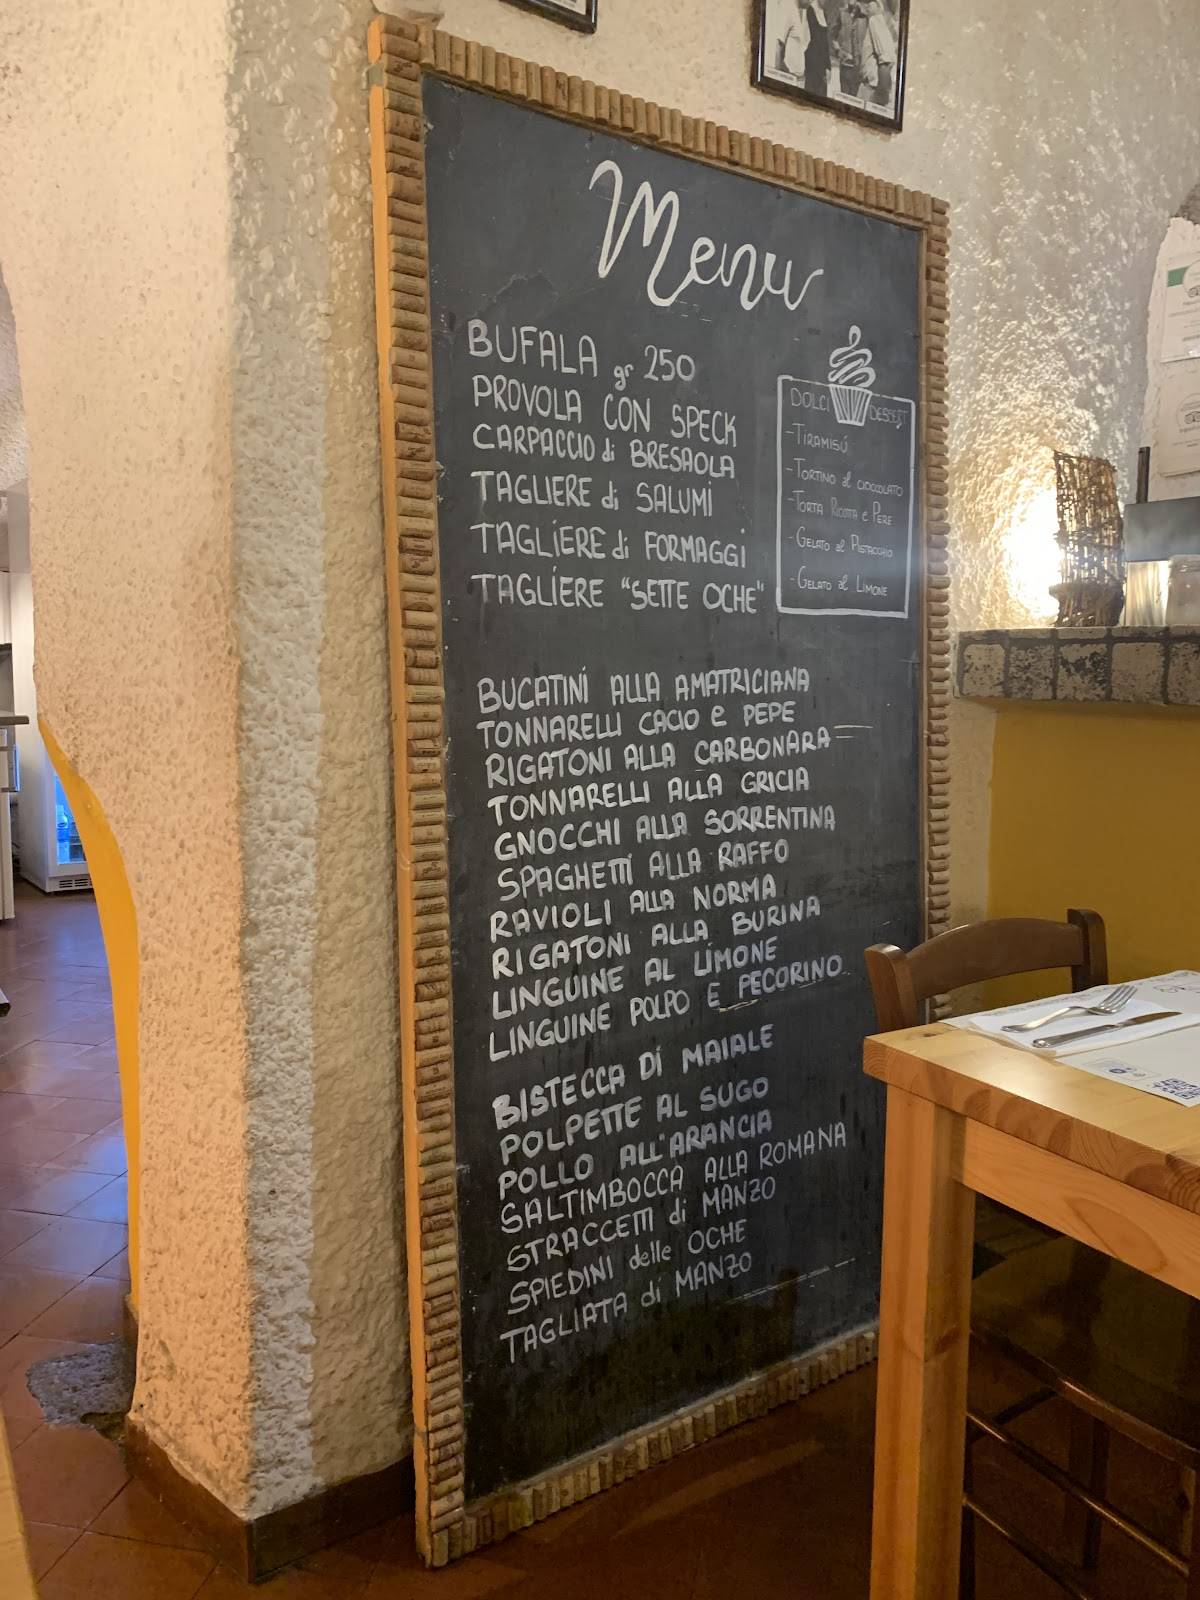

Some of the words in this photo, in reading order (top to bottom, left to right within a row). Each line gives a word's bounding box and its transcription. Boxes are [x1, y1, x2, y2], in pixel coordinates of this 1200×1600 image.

[589, 160, 824, 310] Menu
[468, 319, 598, 377] BUFALA
[613, 364, 634, 391] gr
[644, 345, 696, 381] 250
[472, 374, 582, 424] PROVOLA
[603, 394, 650, 433] CON
[671, 404, 737, 447] SPECK
[791, 388, 830, 412] DOLCI
[473, 423, 596, 462] CARPACCIO
[602, 438, 615, 462] di
[630, 439, 735, 478] BRESAOLA
[471, 471, 592, 507] TAGLIERE
[602, 481, 618, 510] di
[636, 481, 712, 516] SALUMI
[872, 501, 892, 525] PERE
[470, 520, 605, 559] TAGLIERE
[611, 529, 629, 560] di
[645, 528, 746, 568] FORMAGGI
[471, 565, 604, 608] TAGLIERE
[856, 575, 888, 596] LIMONE
[477, 666, 589, 713] BUCATINI
[610, 672, 660, 706] ALLA
[675, 666, 810, 701] AMATRICIANA
[476, 712, 622, 749] TONNARELLI
[639, 708, 700, 735] CACIO
[744, 701, 797, 727] PEPE
[485, 747, 612, 788] RIGATONI
[624, 743, 676, 771] ALLA
[695, 727, 832, 765] CARBONARA
[487, 780, 650, 826] TONNARELLI
[668, 773, 722, 803] ALLA
[741, 767, 809, 794] GRICIA
[494, 818, 620, 861] GNOCCHI
[636, 812, 687, 843] ALLA
[704, 805, 836, 836] SORRENTINA
[497, 853, 634, 901] SPAGHETTI
[650, 848, 702, 880] ALLA
[718, 838, 790, 871] RAFFO
[490, 899, 611, 943] RAVIOLI
[630, 889, 675, 914] ALLA
[694, 873, 777, 911] NORMA
[492, 932, 631, 980] RIGATONI
[651, 920, 709, 946] ALLA
[732, 896, 821, 936] BURINA
[489, 1002, 611, 1062] LINGUINE
[630, 989, 690, 1027] POLPO
[707, 982, 720, 1008] E
[738, 955, 842, 999] PECORINO
[492, 965, 624, 1020] LINGUINE
[644, 957, 676, 986] AL
[694, 936, 778, 977] LIMONE
[492, 1064, 625, 1130] BISTECCA
[639, 1046, 662, 1080] DI
[682, 1023, 775, 1074] MAIALE
[499, 1153, 594, 1200] POLLO
[620, 1109, 773, 1169] ALL'ARANCIA
[500, 1096, 643, 1166] POLPETTE
[656, 1093, 688, 1122] AL
[700, 1076, 769, 1112] SUGO
[501, 1165, 684, 1234] SALTIMBOCCA
[704, 1150, 748, 1183] ALLA
[760, 1121, 846, 1170] ROMANA
[507, 1207, 653, 1272] STRACCETTI
[669, 1200, 686, 1225] di
[703, 1177, 776, 1218] MANZO
[508, 1256, 613, 1315] SPIEDINI
[629, 1240, 671, 1270] delle
[688, 1219, 748, 1254] OCHE
[500, 1292, 627, 1363] TAGLIATA
[641, 1278, 661, 1308] di
[675, 1253, 751, 1298] MANZO
